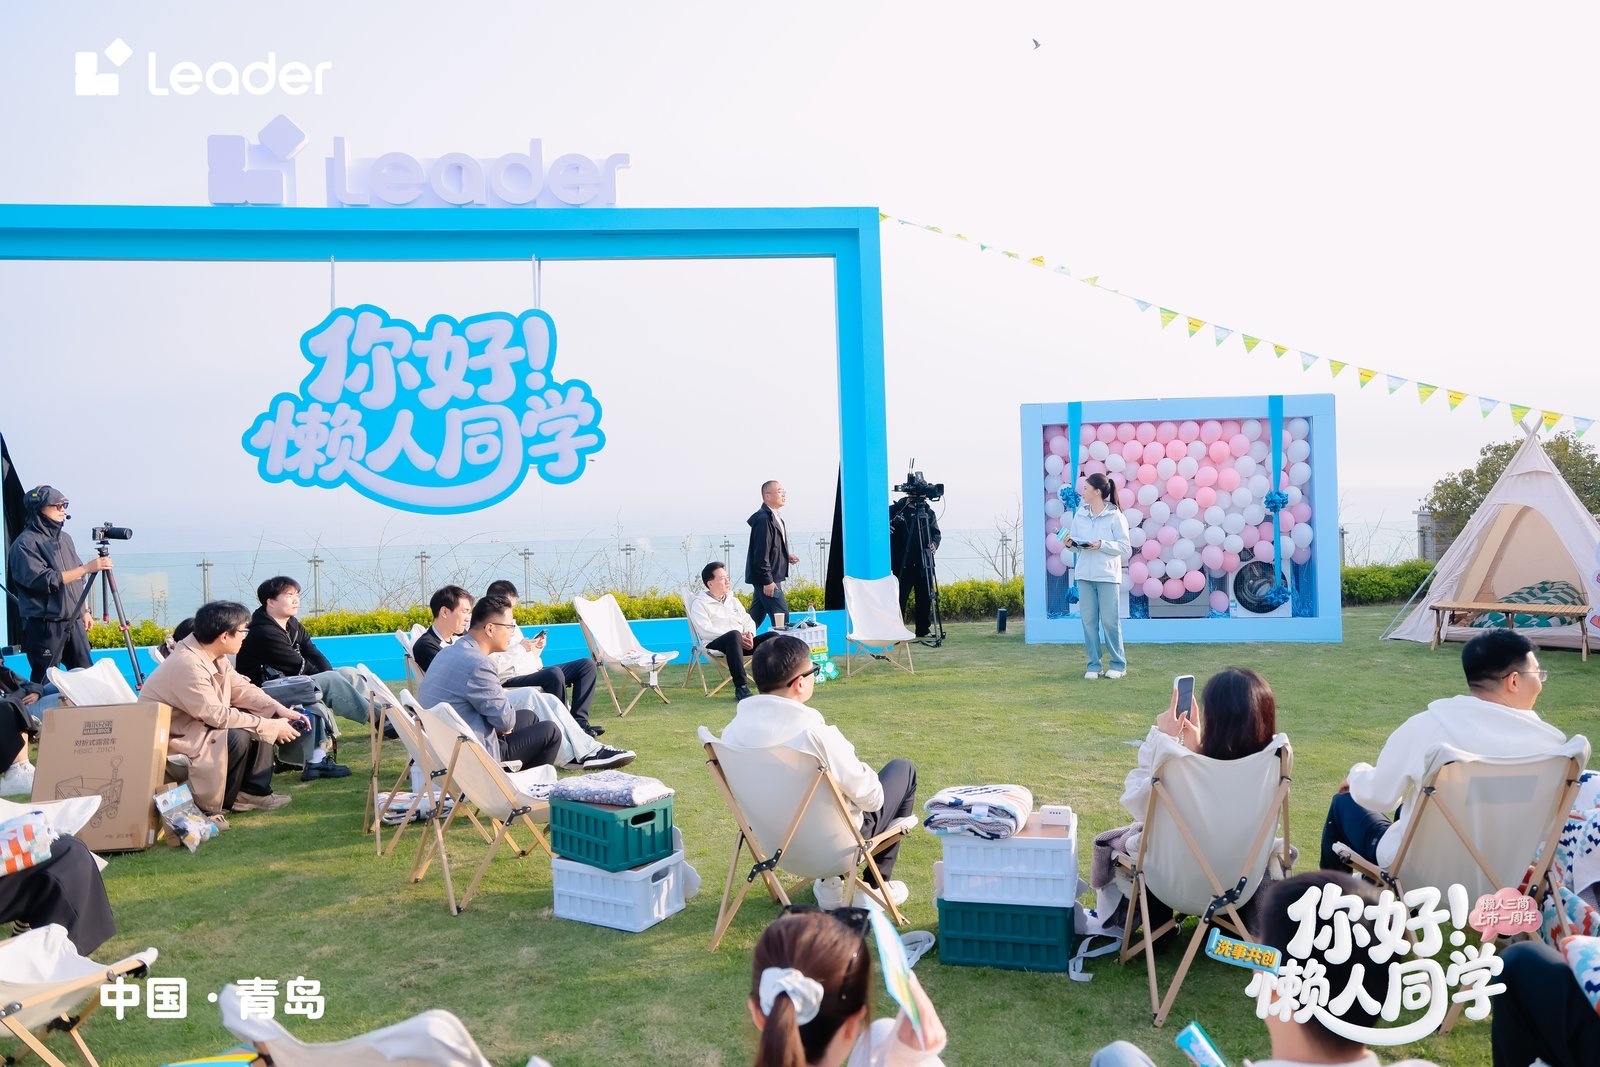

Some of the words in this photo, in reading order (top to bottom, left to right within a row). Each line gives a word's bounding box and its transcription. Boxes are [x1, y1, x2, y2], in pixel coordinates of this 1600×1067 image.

[330, 136, 631, 206] Leader
[250, 386, 599, 507] 懒人同学
